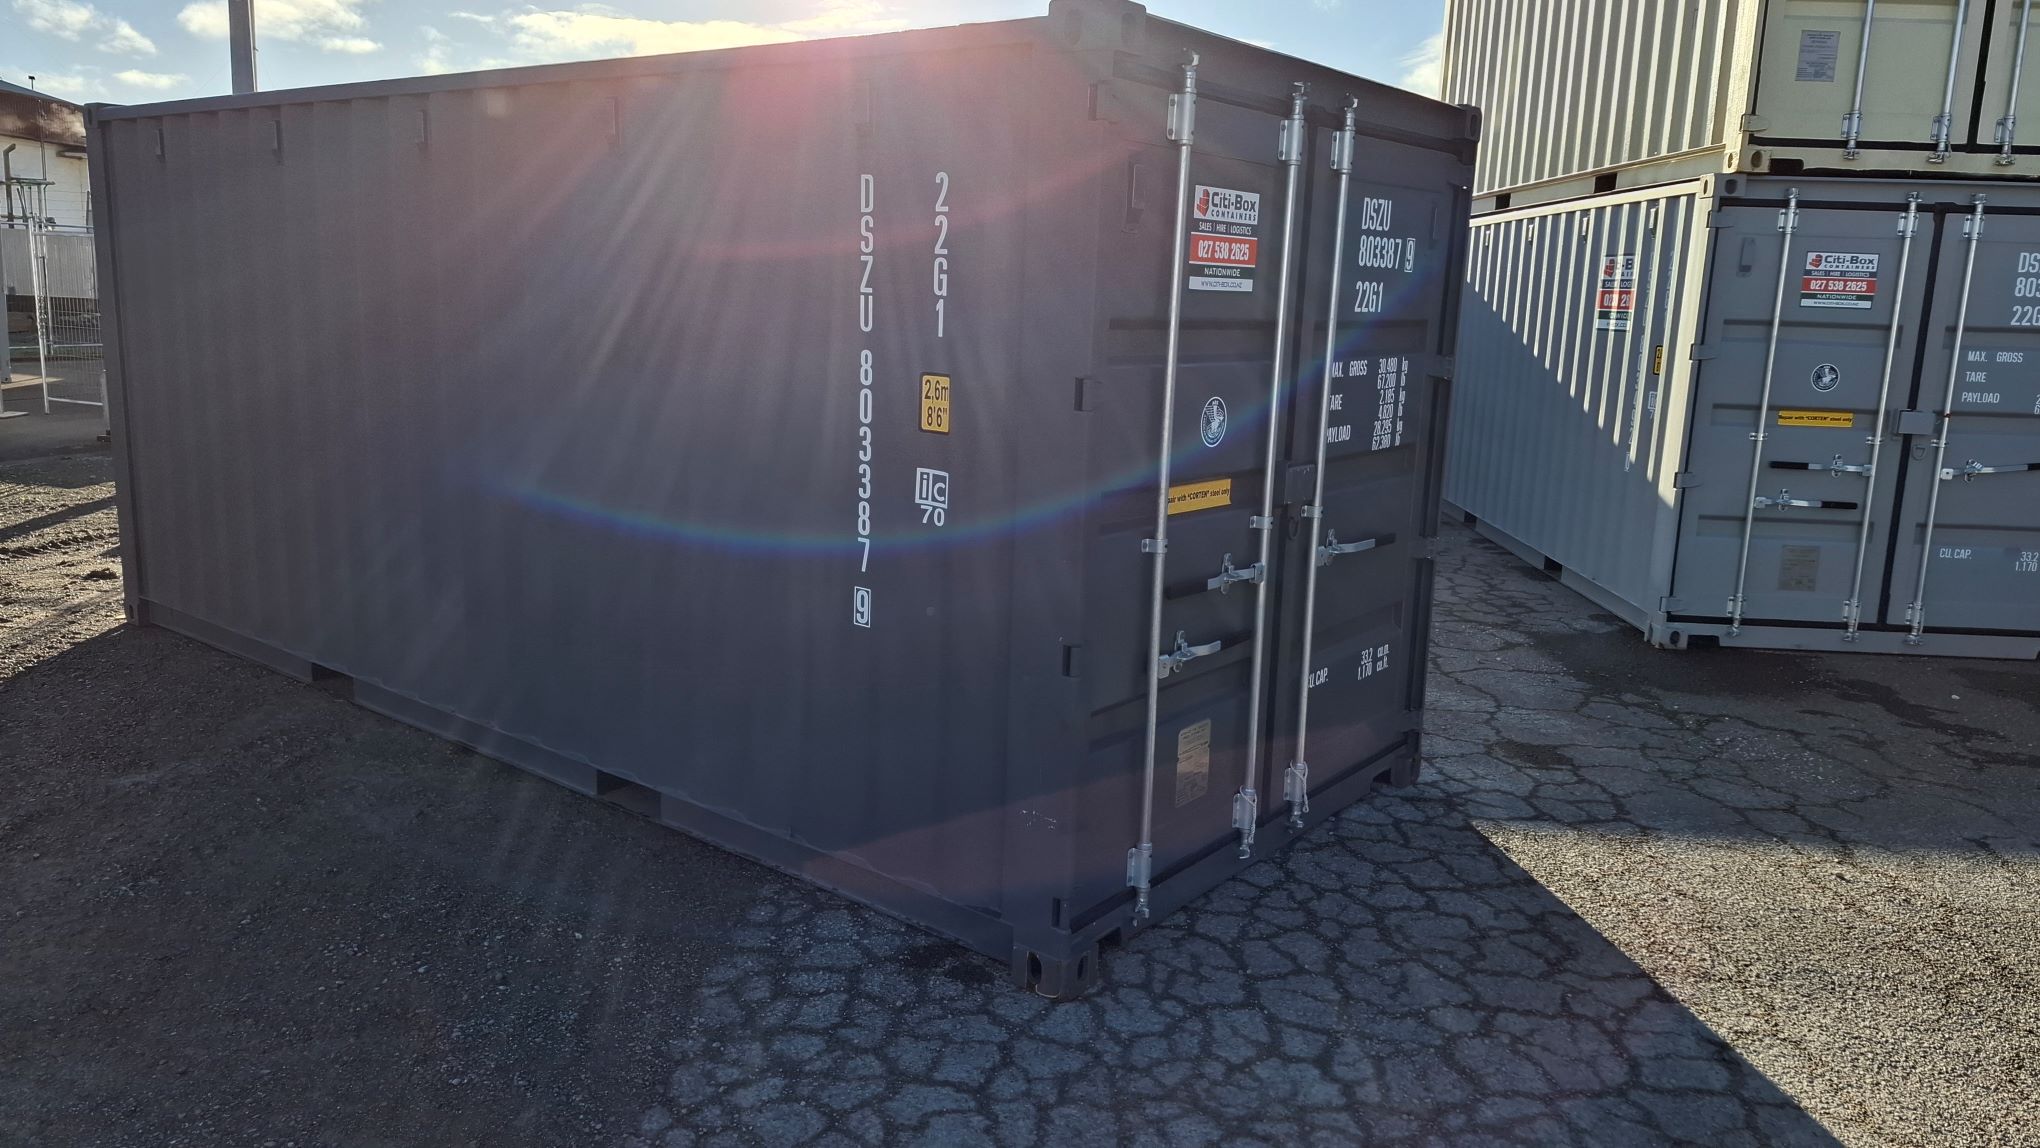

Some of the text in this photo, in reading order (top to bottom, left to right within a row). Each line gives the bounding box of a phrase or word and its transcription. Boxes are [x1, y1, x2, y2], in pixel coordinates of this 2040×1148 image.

[1211, 191, 1257, 212] Citi-Box
[1211, 209, 1257, 221] CONTAINERS
[1361, 197, 1392, 231] DSZU
[1199, 221, 1252, 235] SALES HIRE LOGISTICS
[934, 172, 949, 337] 22G1
[1198, 240, 1249, 261] 027 538 2625
[1359, 234, 1415, 271] 803387 9
[1824, 255, 1875, 266] Citi-Box
[2018, 252, 2040, 273] DS
[1204, 267, 1241, 277] NATIONWIDE
[1810, 280, 1867, 292] 027 538 2625
[1354, 281, 1383, 313] 22G1
[1968, 351, 2024, 363] MAX. GROSS
[1349, 360, 1367, 377] GROSS
[1965, 372, 1987, 382] TARE
[856, 174, 874, 624] DSZU 803387 9
[1330, 393, 1343, 411] ARE
[1961, 392, 2000, 403] PAYLOAD
[1326, 425, 1351, 444] AYLOAD
[920, 505, 945, 527] 70
[1954, 548, 1972, 560] CAP.
[1315, 667, 1329, 685] CAP.
